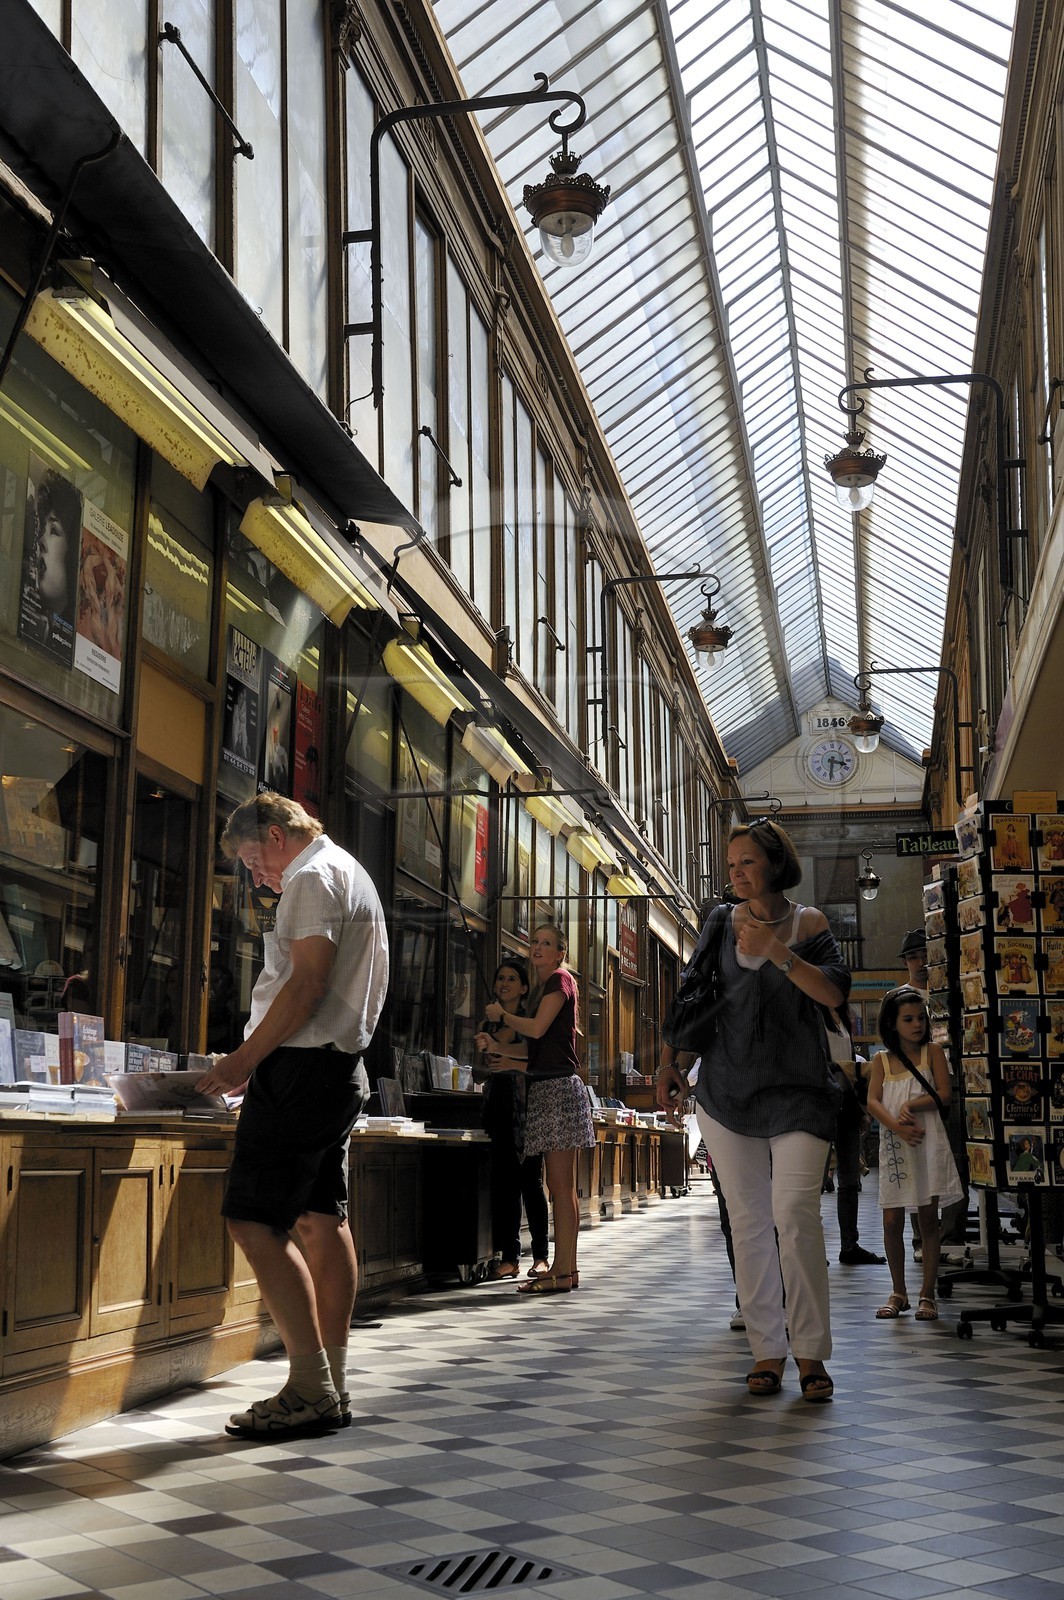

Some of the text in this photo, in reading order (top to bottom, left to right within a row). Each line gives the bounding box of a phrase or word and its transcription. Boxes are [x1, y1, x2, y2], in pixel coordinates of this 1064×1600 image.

[817, 717, 845, 728] 1846
[1007, 942, 1033, 950] SUCHARD
[1005, 1070, 1039, 1082] LE CHAT
